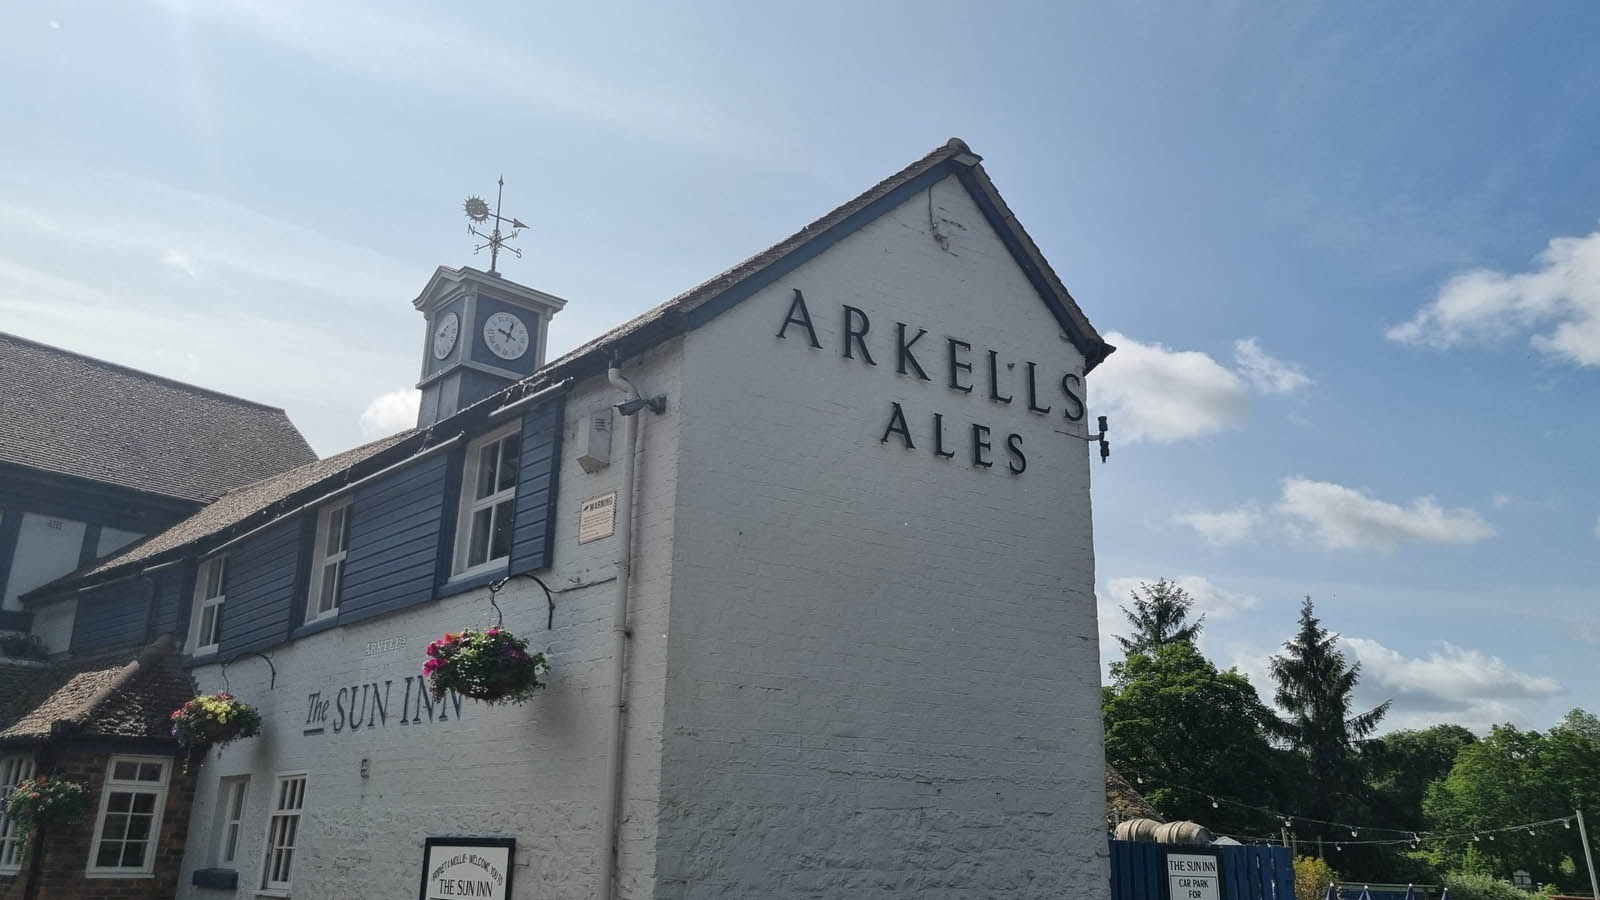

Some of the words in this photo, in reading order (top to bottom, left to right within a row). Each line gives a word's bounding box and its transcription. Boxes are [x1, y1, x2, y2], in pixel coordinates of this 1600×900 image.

[880, 401, 1027, 475] ALES
[306, 691, 330, 724] The
[333, 680, 392, 733] SUN
[400, 675, 463, 725] INN
[469, 854, 491, 872] WELCOME
[1168, 860, 1185, 871] THE
[1186, 861, 1201, 872] SUN
[1202, 861, 1216, 872] INN
[439, 879, 456, 895] THE
[457, 880, 475, 897] SUN
[476, 880, 493, 898] INN
[1178, 879, 1191, 888] CAR
[1192, 879, 1209, 889] PARK
[1188, 890, 1202, 899] FOR
